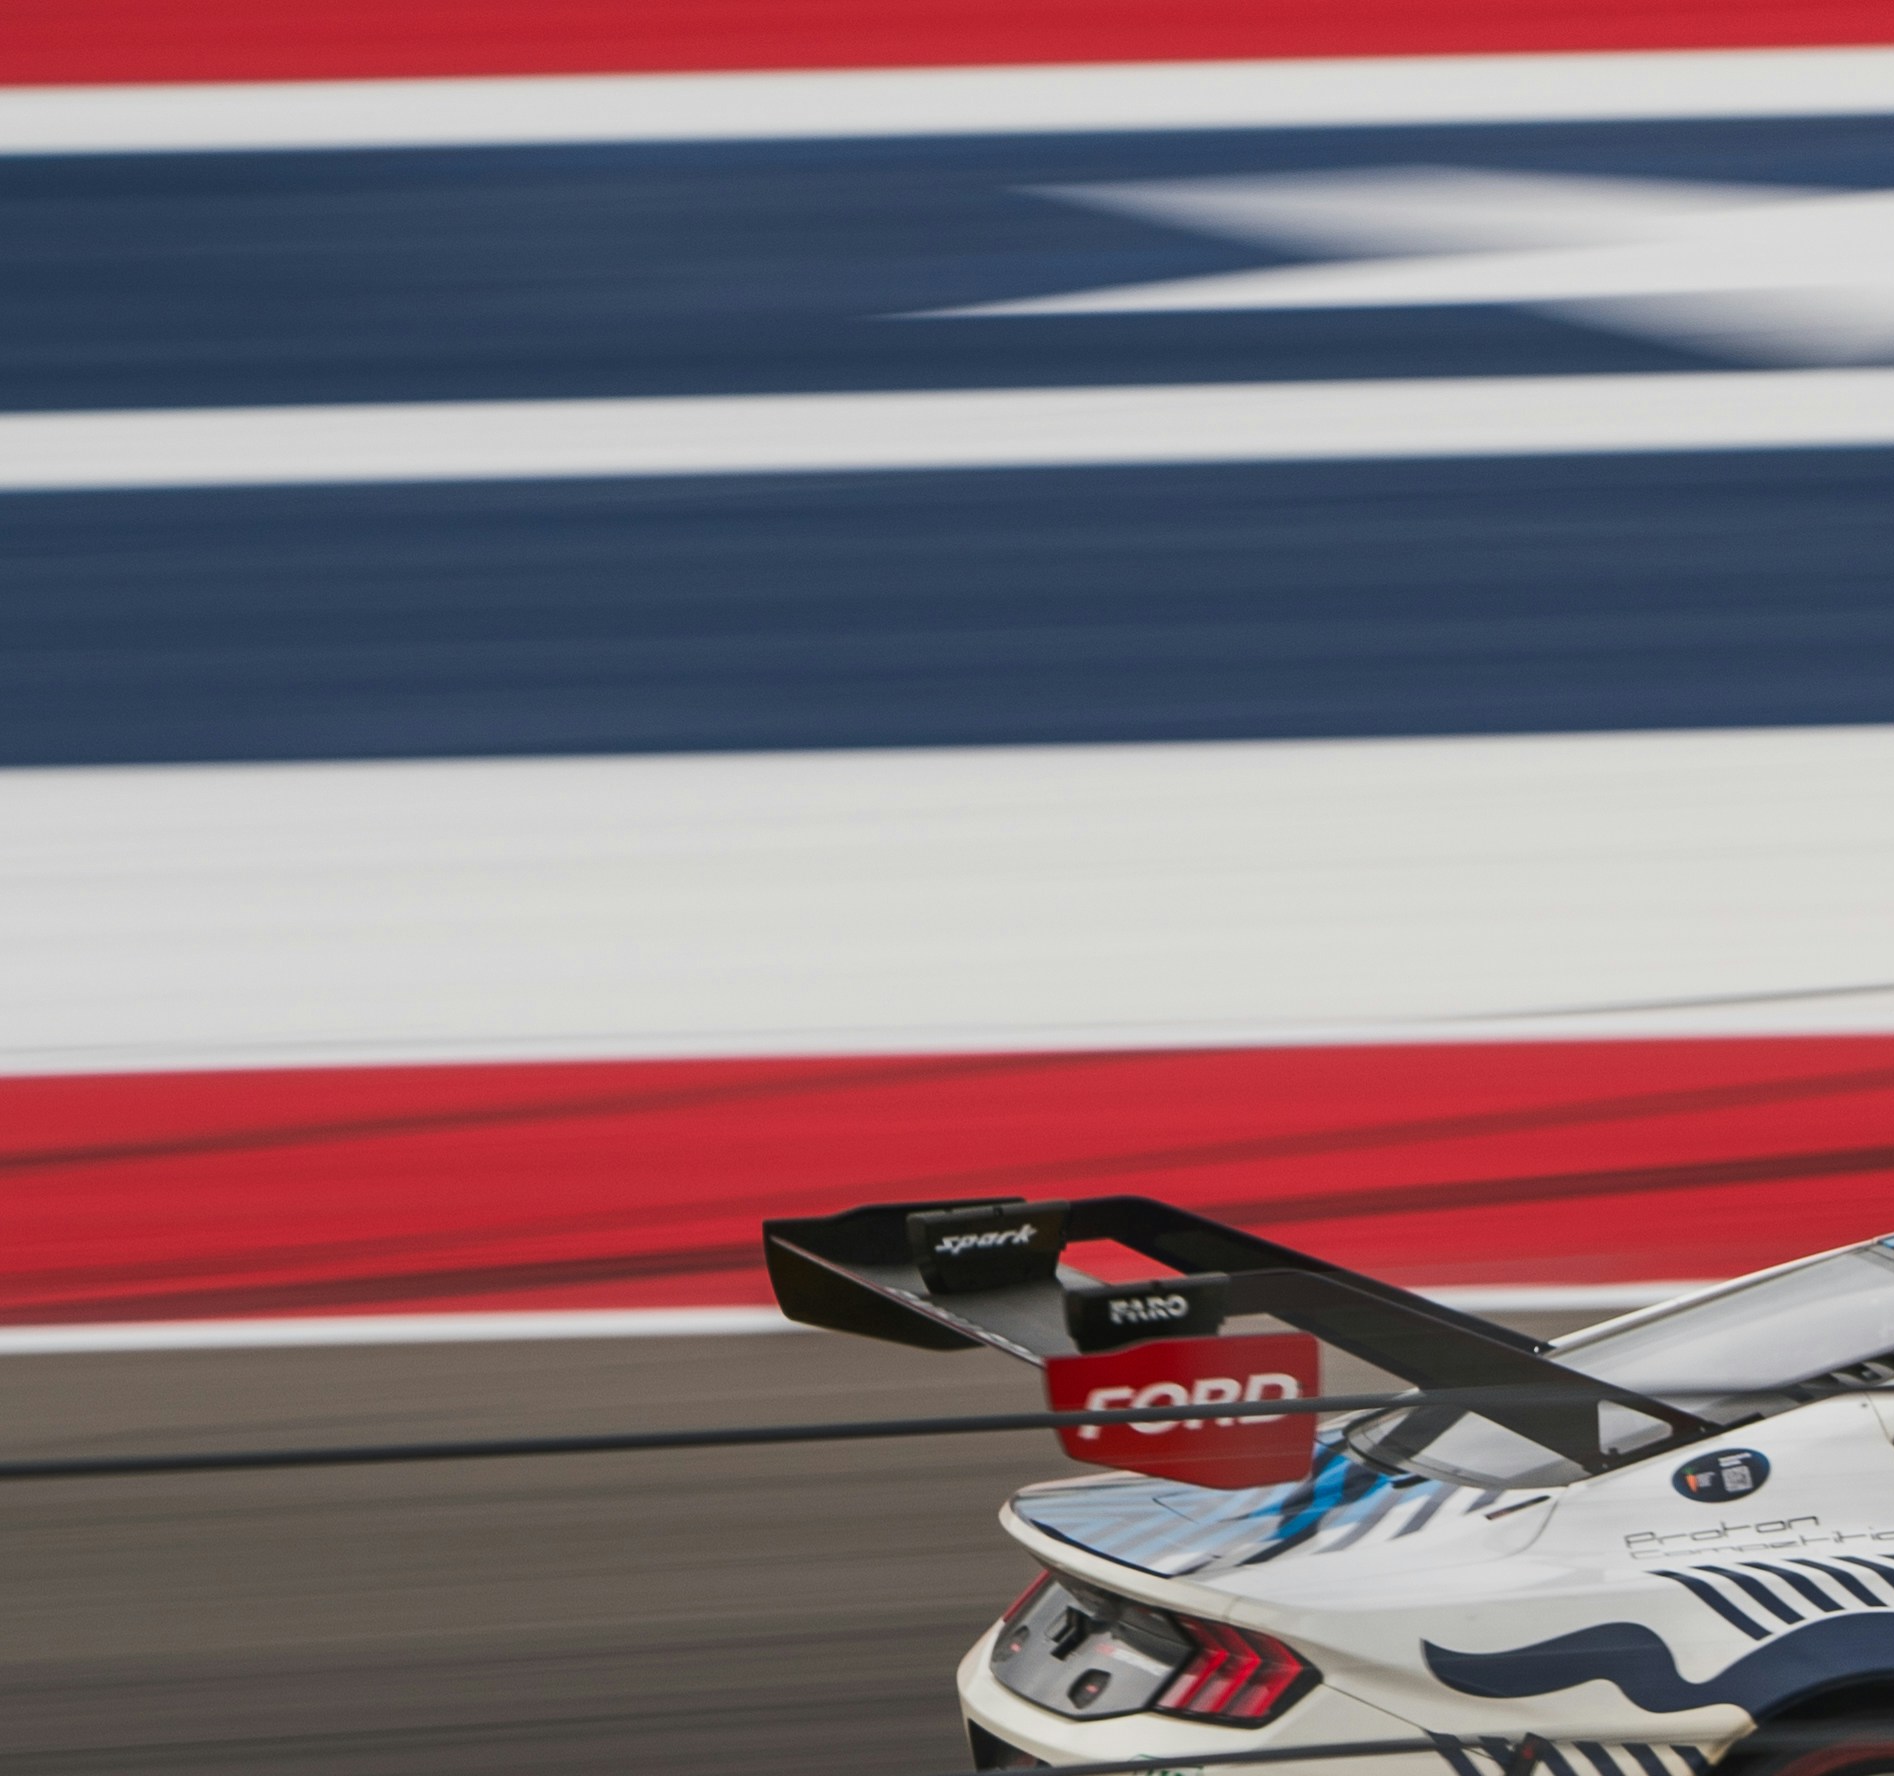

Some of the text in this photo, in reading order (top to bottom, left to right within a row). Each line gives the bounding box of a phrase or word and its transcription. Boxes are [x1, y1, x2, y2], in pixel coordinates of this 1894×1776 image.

[935, 1224, 1037, 1254] spark
[1109, 1295, 1188, 1325] FARO
[1077, 1373, 1302, 1440] FORD
[1625, 1516, 1819, 1549] Proton
